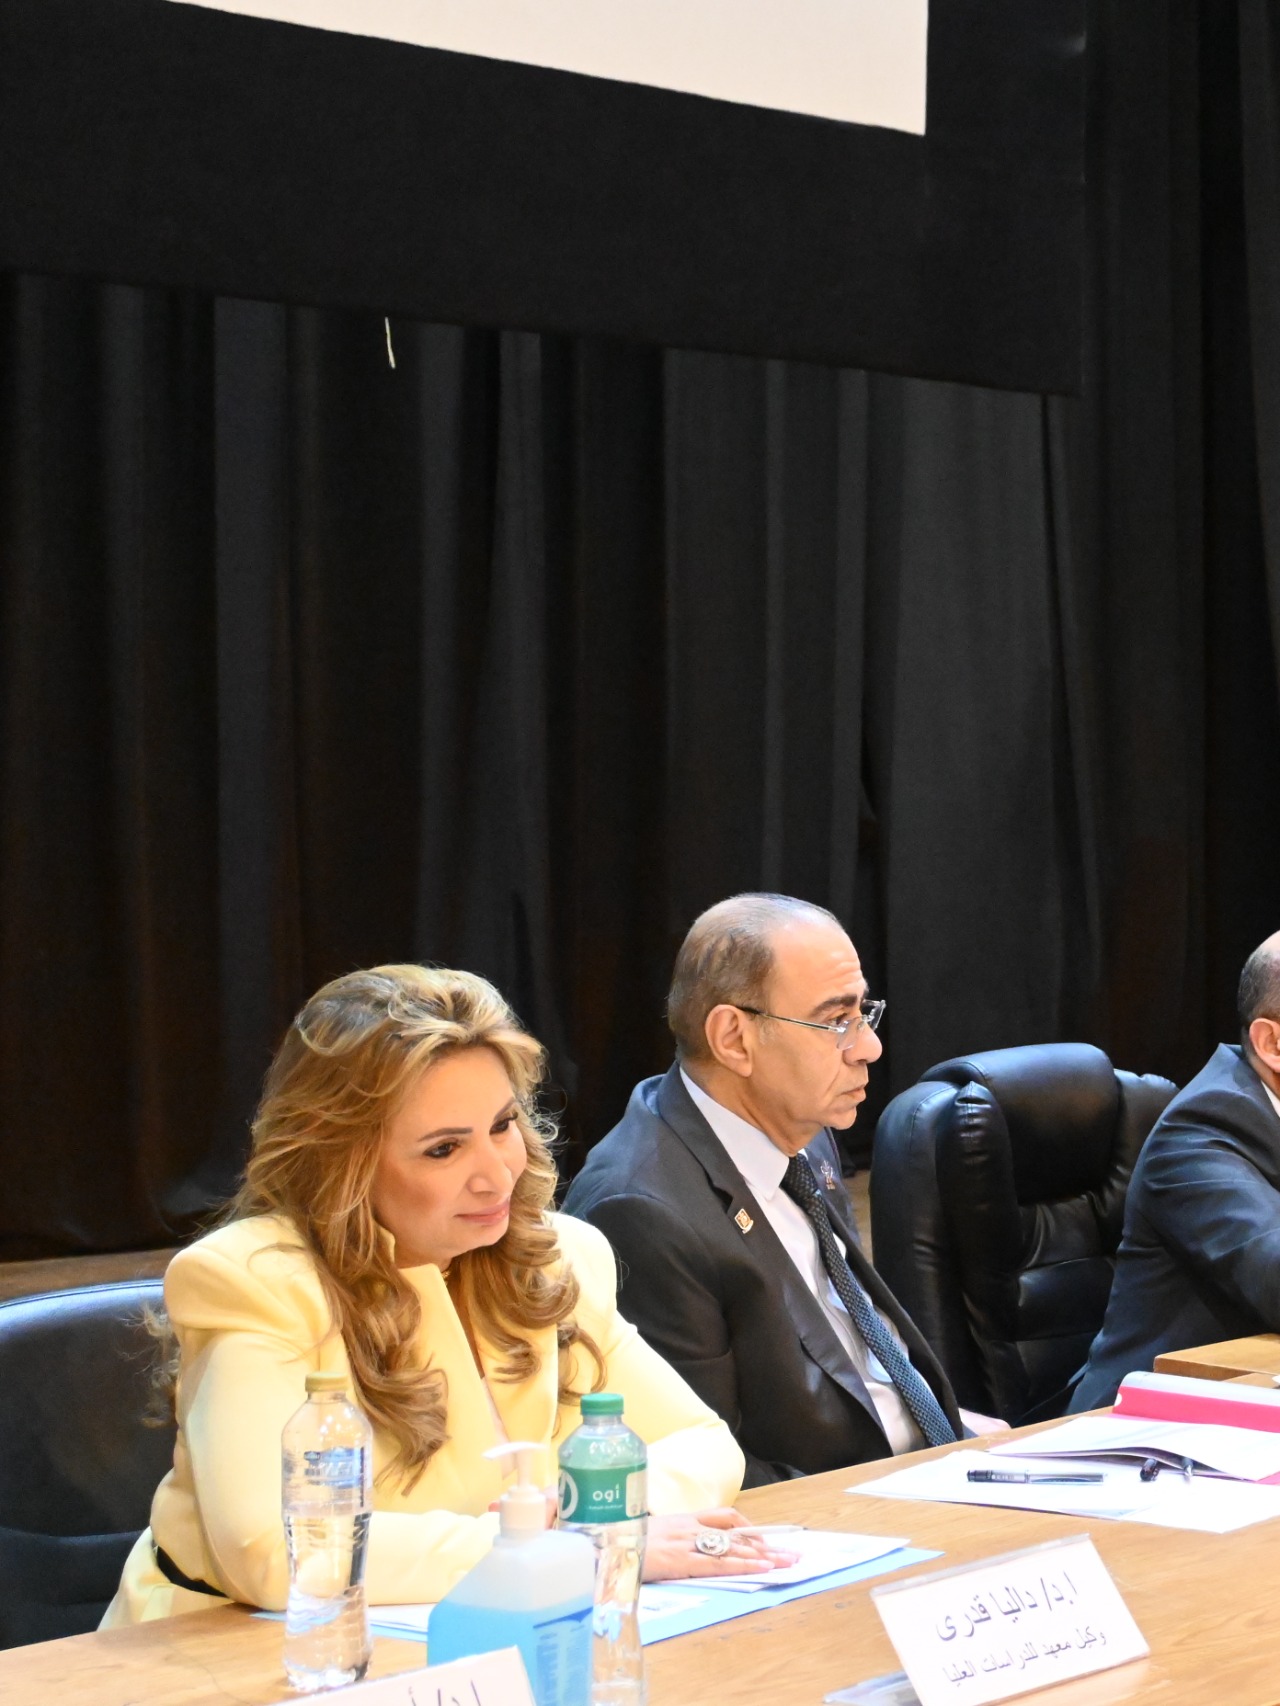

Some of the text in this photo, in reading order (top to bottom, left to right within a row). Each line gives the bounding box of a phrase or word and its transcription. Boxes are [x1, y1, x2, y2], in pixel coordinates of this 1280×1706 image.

[937, 1594, 992, 1642] قدرى
[988, 1586, 1039, 1624] داليا
[1042, 1641, 1073, 1660] معهد
[1075, 1625, 1108, 1650] وكيل
[942, 1660, 978, 1688] العليا
